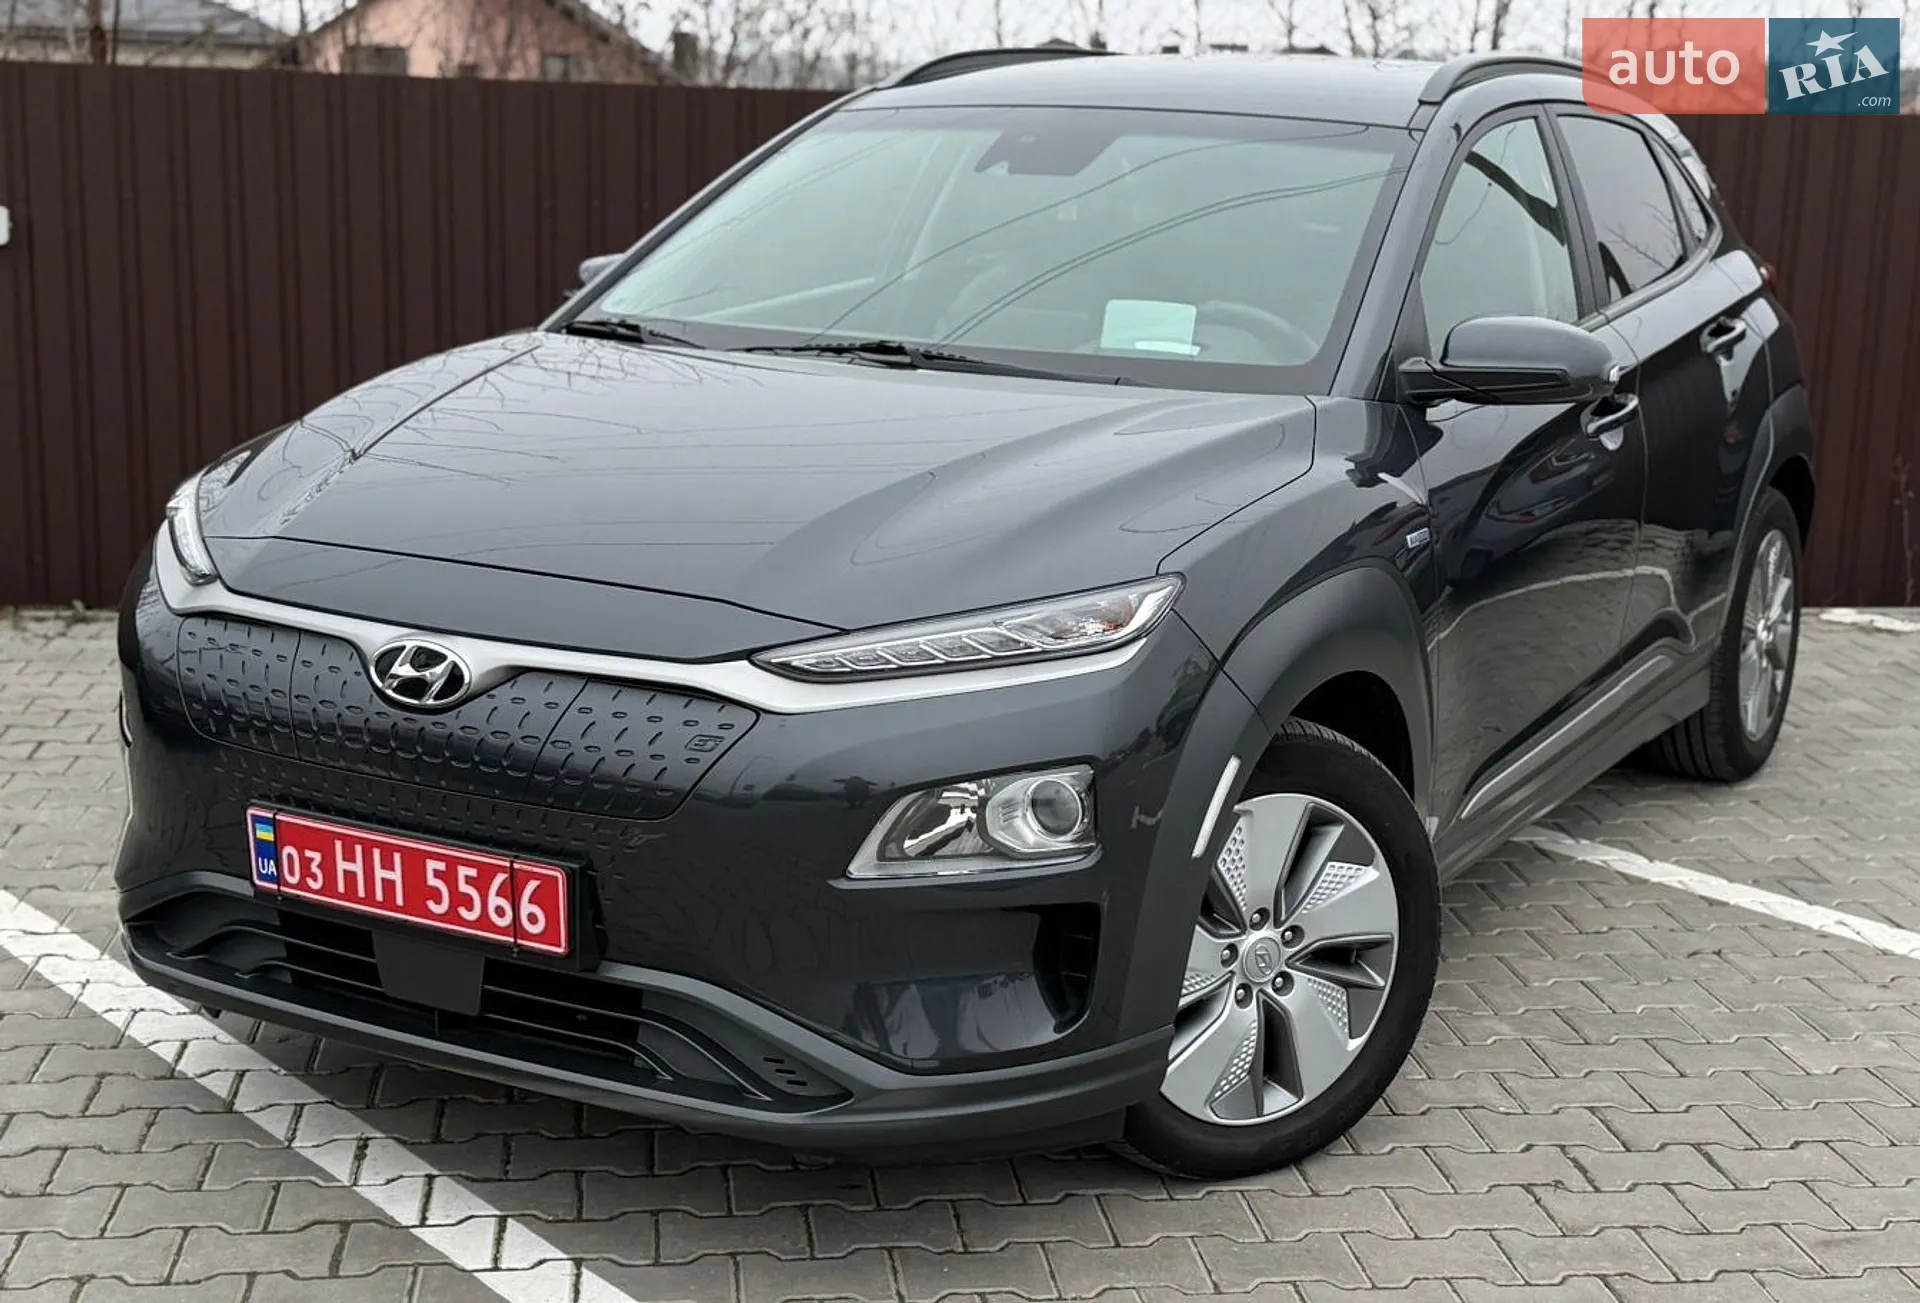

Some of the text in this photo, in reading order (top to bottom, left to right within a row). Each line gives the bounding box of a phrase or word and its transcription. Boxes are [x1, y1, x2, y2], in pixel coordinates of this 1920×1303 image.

[258, 857, 277, 876] UA
[282, 840, 546, 934] 03 HH 5566
